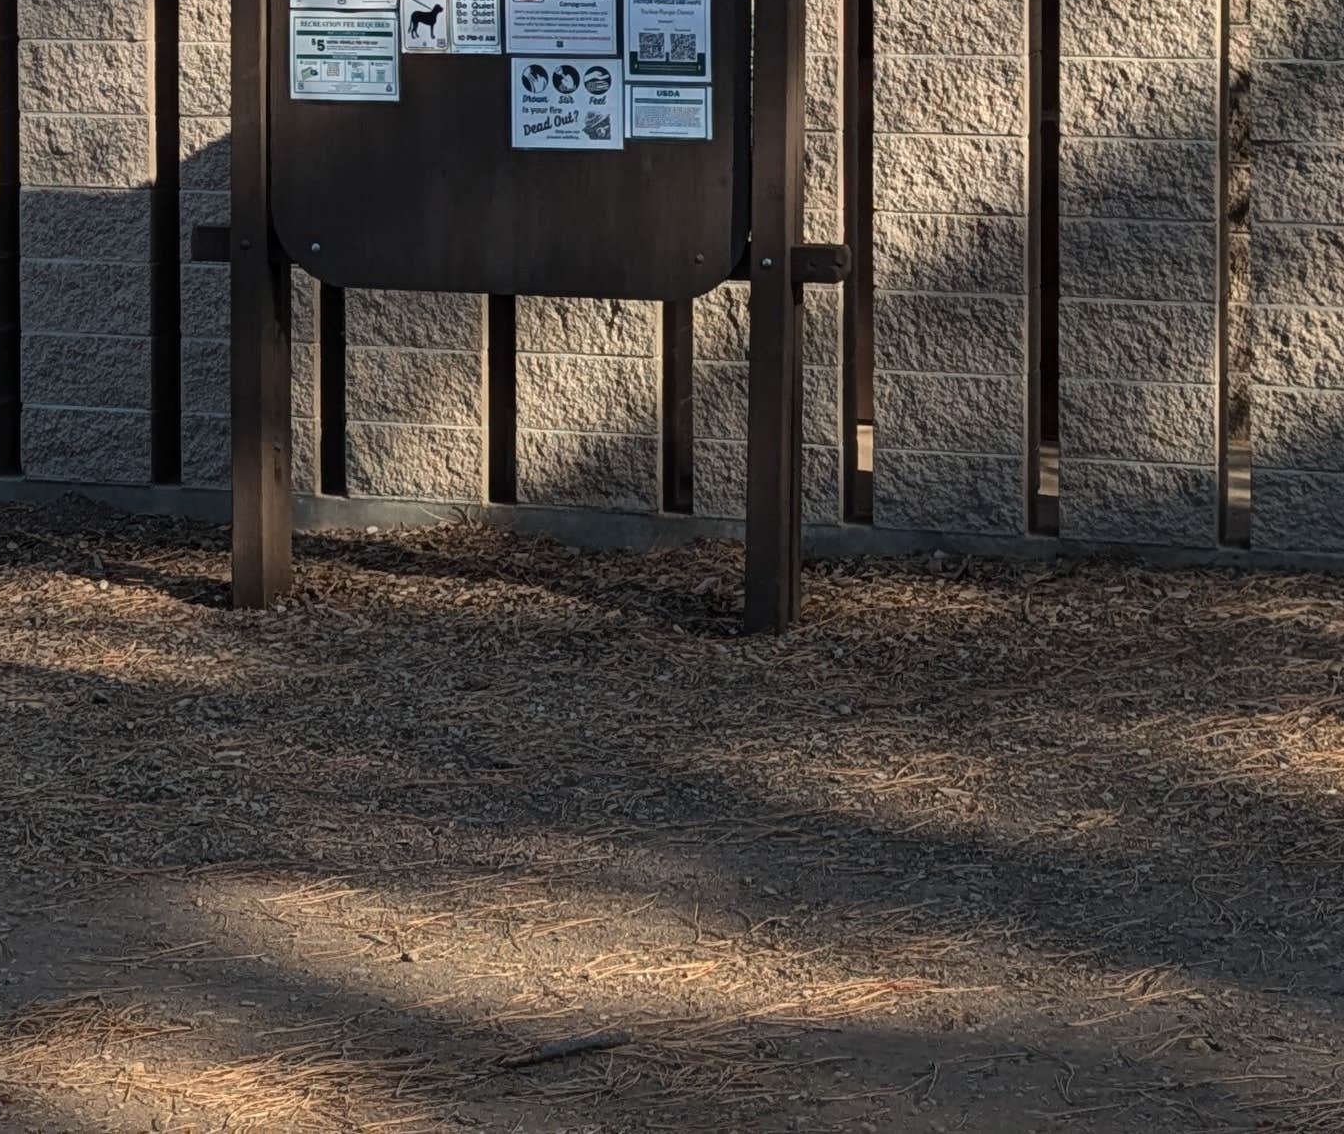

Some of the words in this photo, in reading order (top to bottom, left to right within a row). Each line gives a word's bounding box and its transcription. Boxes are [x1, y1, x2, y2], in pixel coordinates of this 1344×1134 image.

[531, 107, 547, 115] your
[549, 106, 562, 114] fire
[523, 115, 552, 136] Dead
[554, 110, 579, 127] Out?
